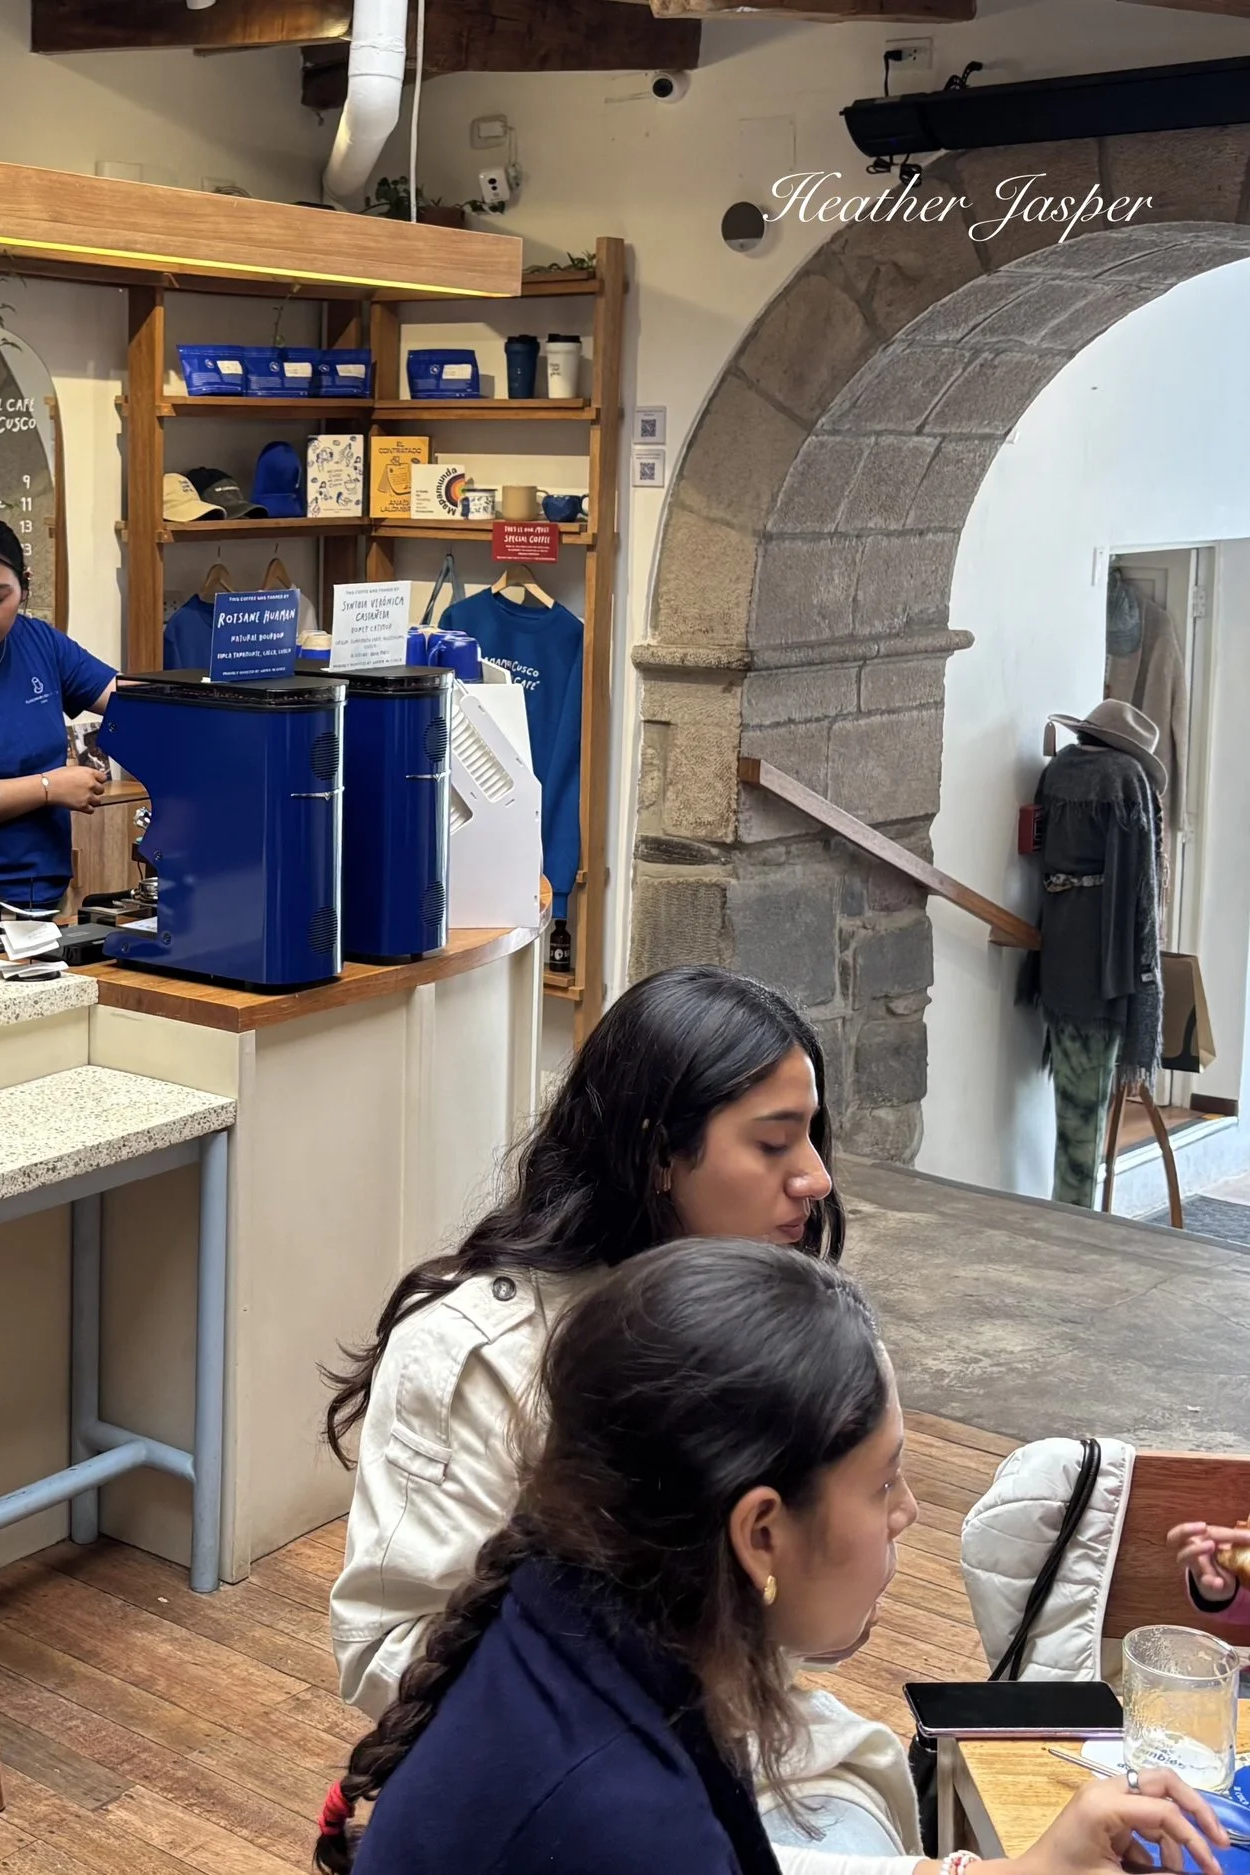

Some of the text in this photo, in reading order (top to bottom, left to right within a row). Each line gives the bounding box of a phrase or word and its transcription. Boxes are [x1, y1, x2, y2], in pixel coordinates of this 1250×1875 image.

[22, 475, 31, 489] 9
[20, 497, 32, 511] 11
[20, 520, 33, 533] 13
[504, 534, 550, 544] SPECIAL COFFEE
[511, 660, 539, 677] CUSCO
